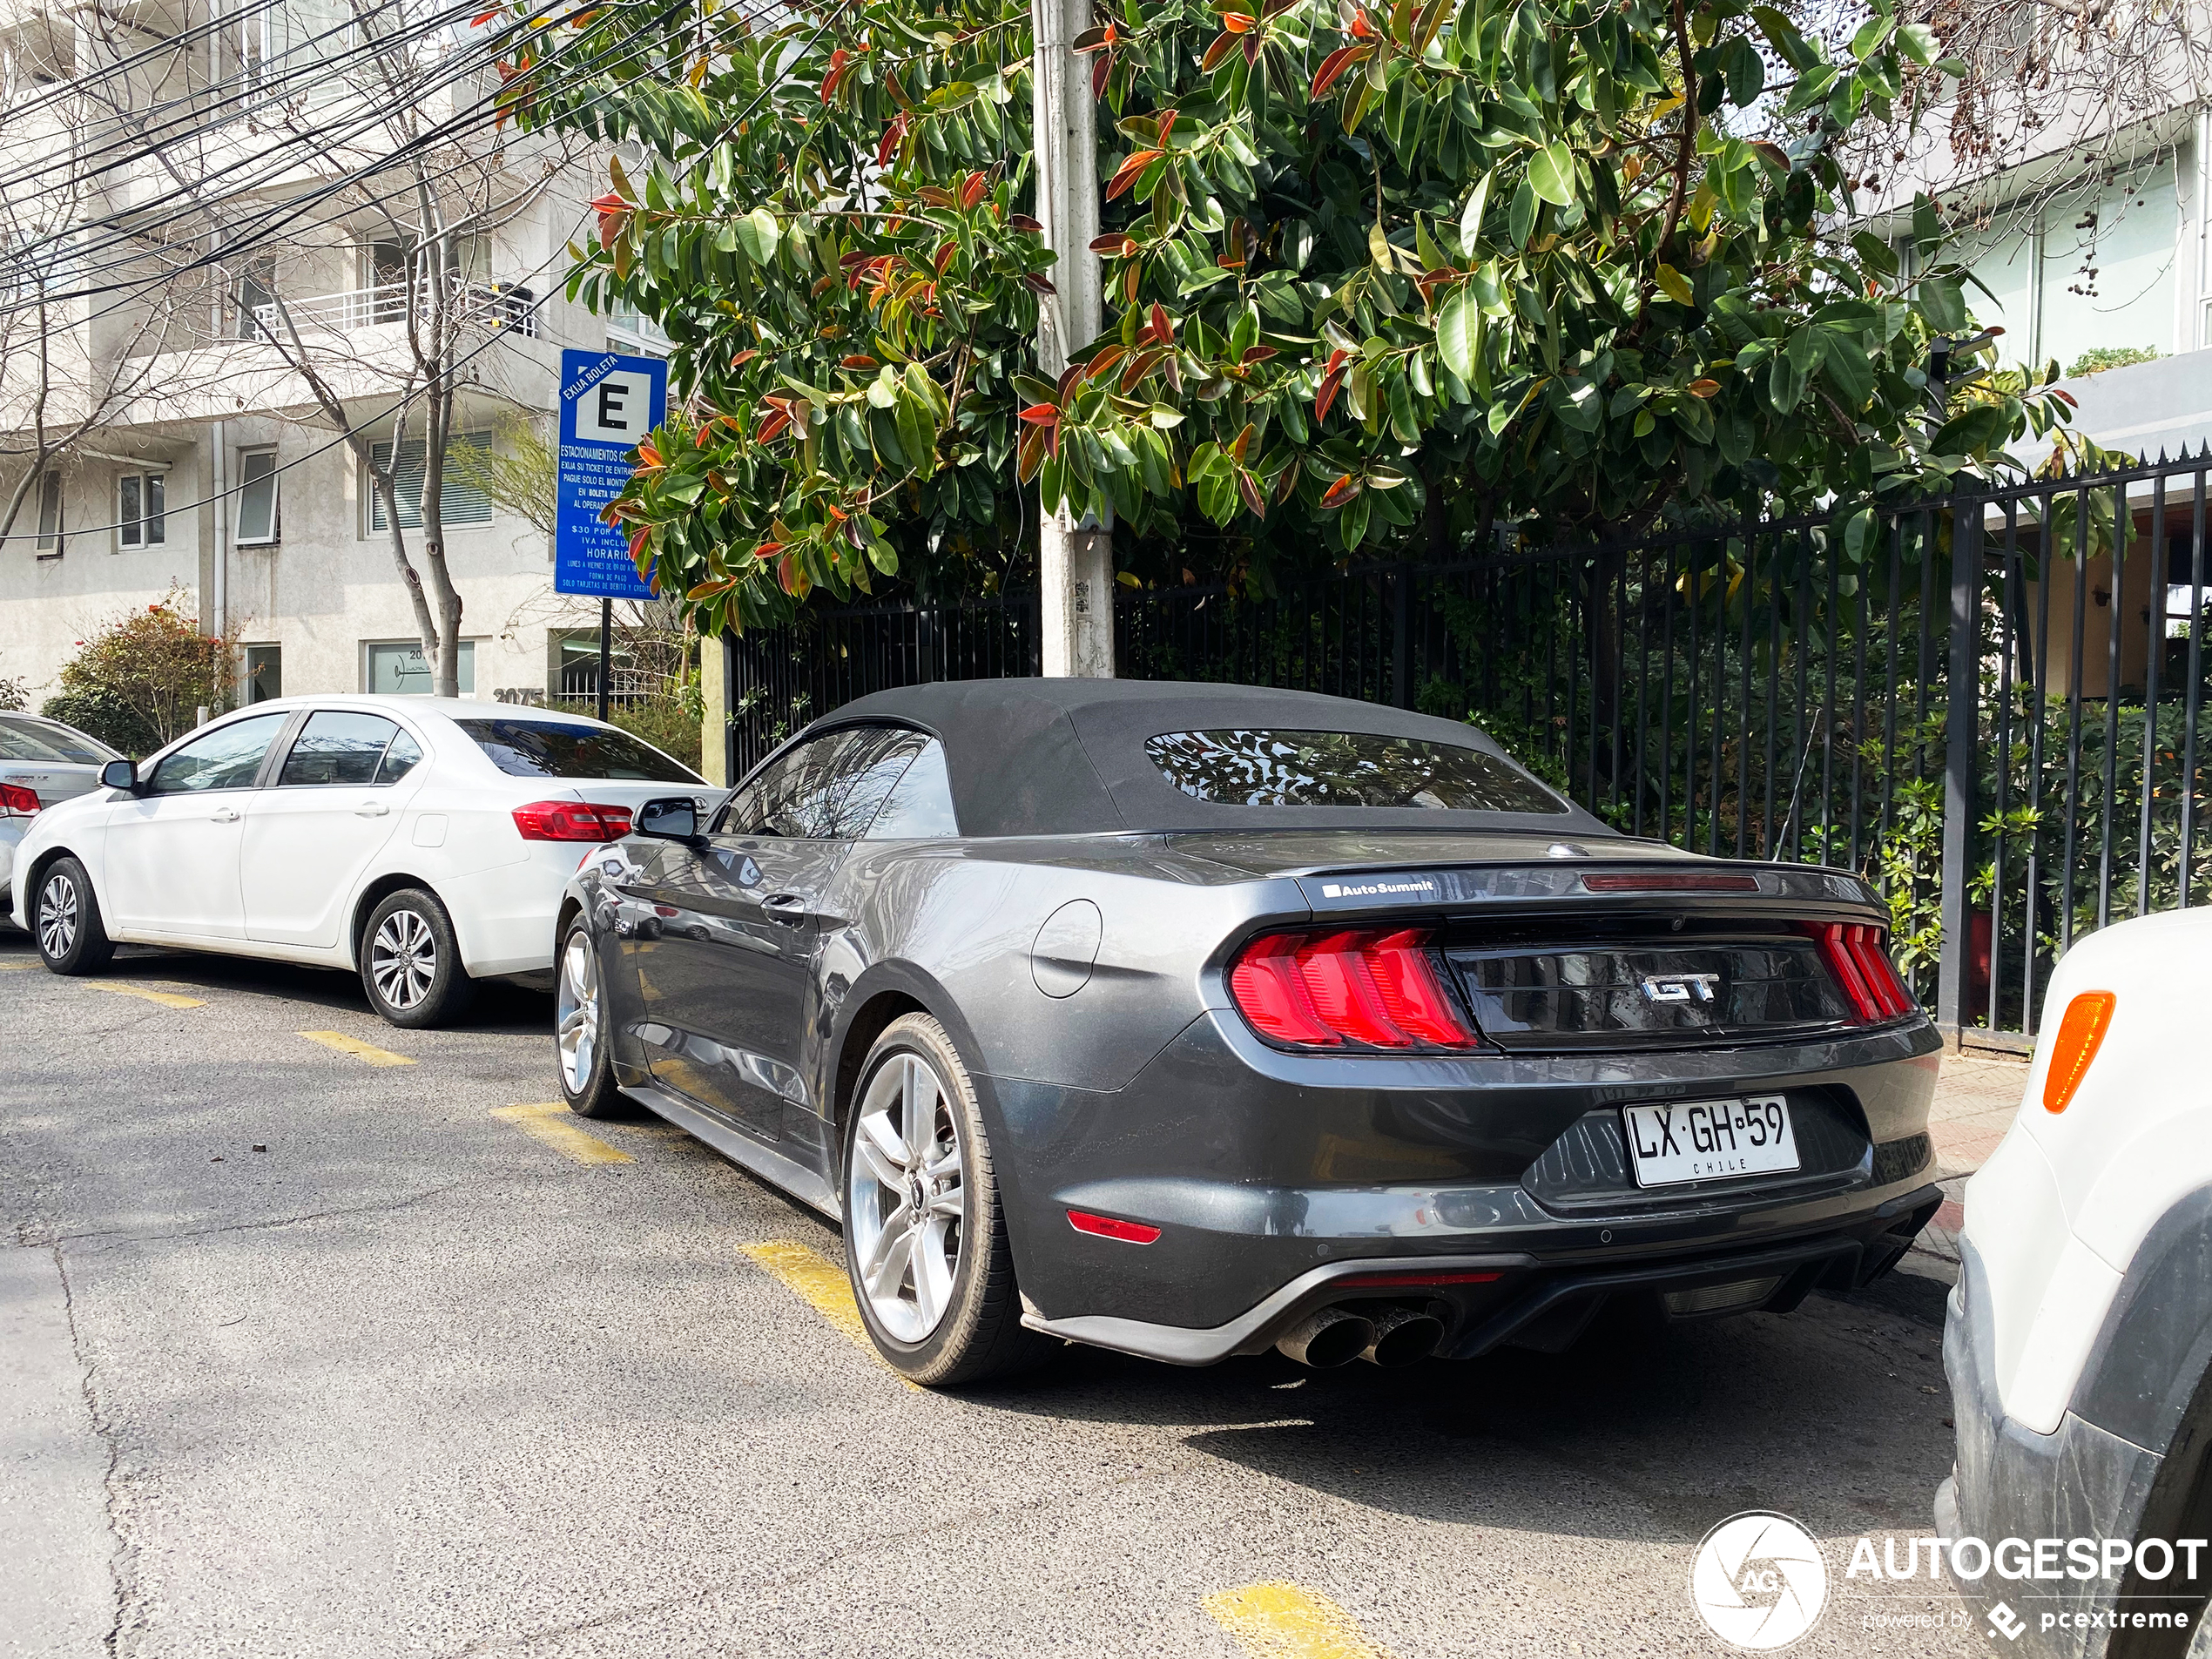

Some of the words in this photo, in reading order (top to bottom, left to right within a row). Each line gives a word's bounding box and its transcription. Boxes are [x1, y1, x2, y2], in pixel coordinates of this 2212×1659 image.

[563, 378, 589, 401] EXIJA
[586, 354, 618, 383] BOLETA
[598, 383, 630, 430] E
[561, 444, 618, 462] ESTACIONAMIENTOS
[561, 462, 576, 470] EXIJA
[577, 462, 585, 471] SU
[585, 463, 604, 473] TICKET
[605, 465, 612, 474] DE
[613, 466, 636, 476] ENTRAD
[563, 474, 581, 483] PAGUE
[582, 475, 597, 485] SOLO
[598, 477, 605, 486] EL
[578, 488, 586, 497] EN
[589, 489, 608, 498] BOLETA
[573, 499, 582, 509] AL
[571, 525, 590, 534] $30
[594, 527, 611, 536] POR
[582, 536, 597, 545] IVA
[601, 538, 629, 548] INCLUI
[586, 548, 630, 561] HORARIO
[614, 574, 627, 583] PAGO
[577, 580, 600, 590] TARJETAS
[633, 584, 650, 593] CREDIT
[493, 688, 545, 709] 2075
[1342, 880, 1434, 897] AutoSummit
[1641, 973, 1720, 1005] GT
[1693, 1158, 1747, 1174] CHILE
